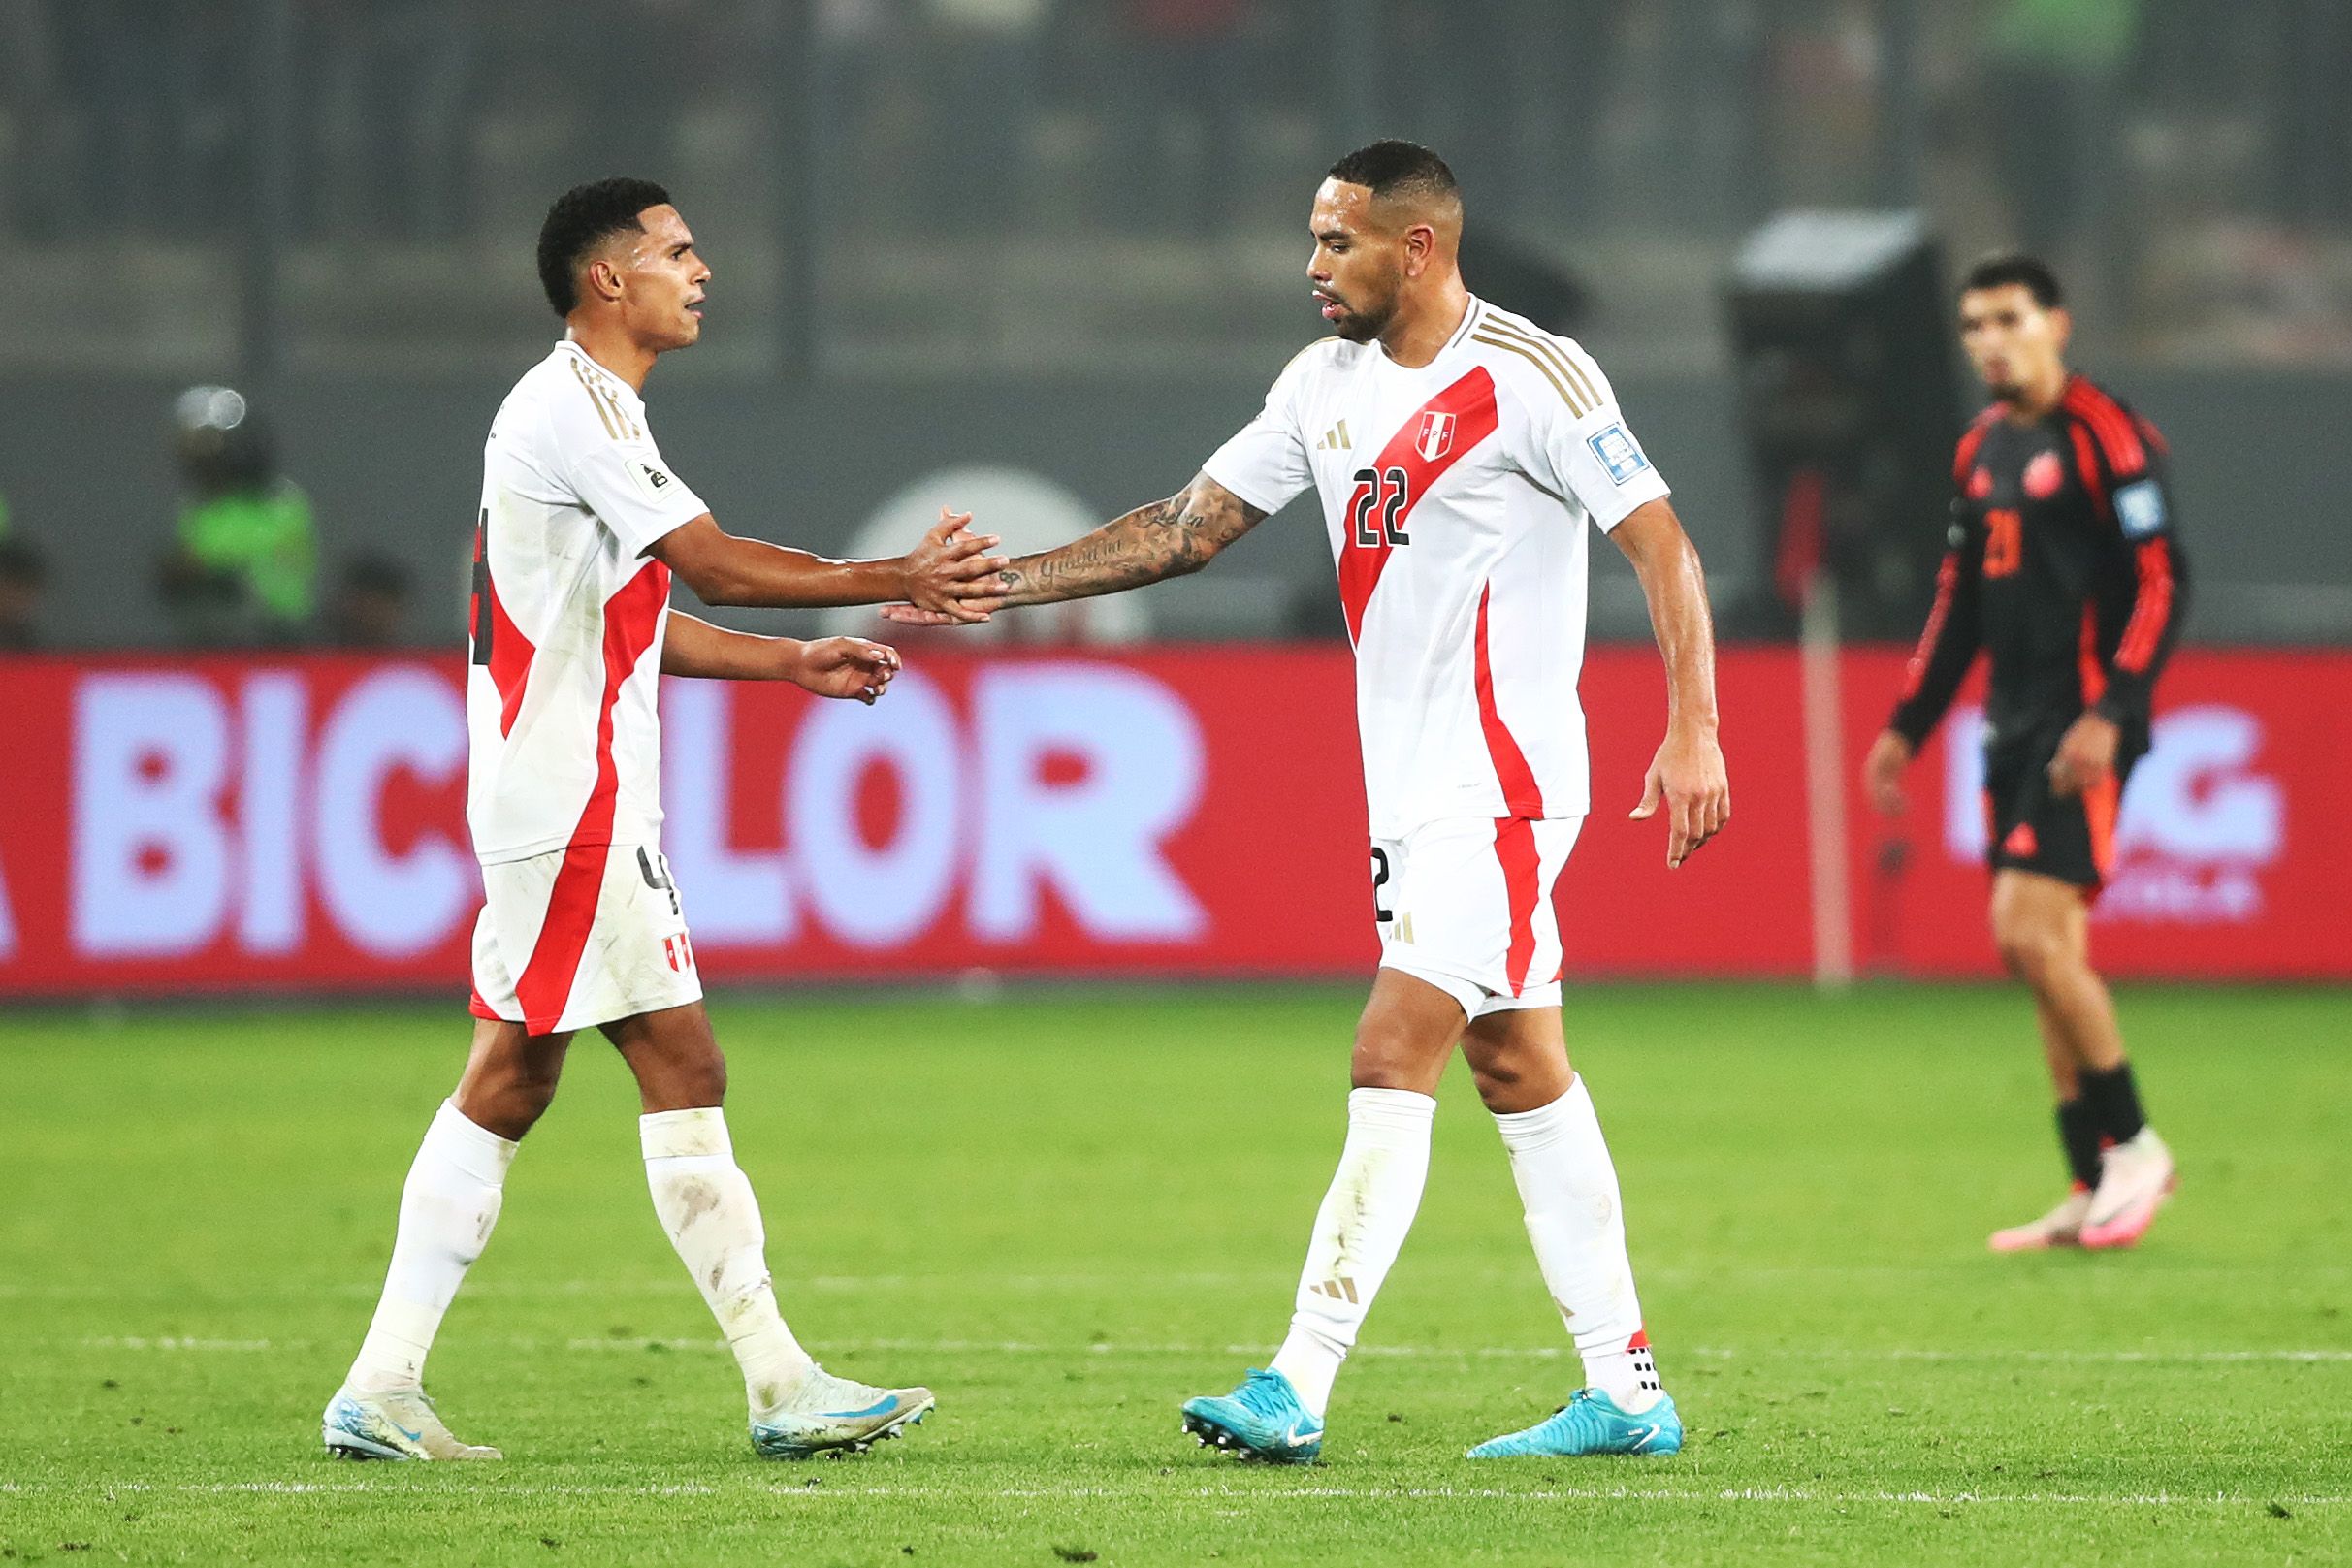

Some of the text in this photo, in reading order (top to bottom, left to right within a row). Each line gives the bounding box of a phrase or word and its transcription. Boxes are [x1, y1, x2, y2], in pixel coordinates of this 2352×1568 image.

[1353, 466, 1410, 548] 22
[72, 663, 1212, 956] BICLOR
[636, 845, 679, 915] 4
